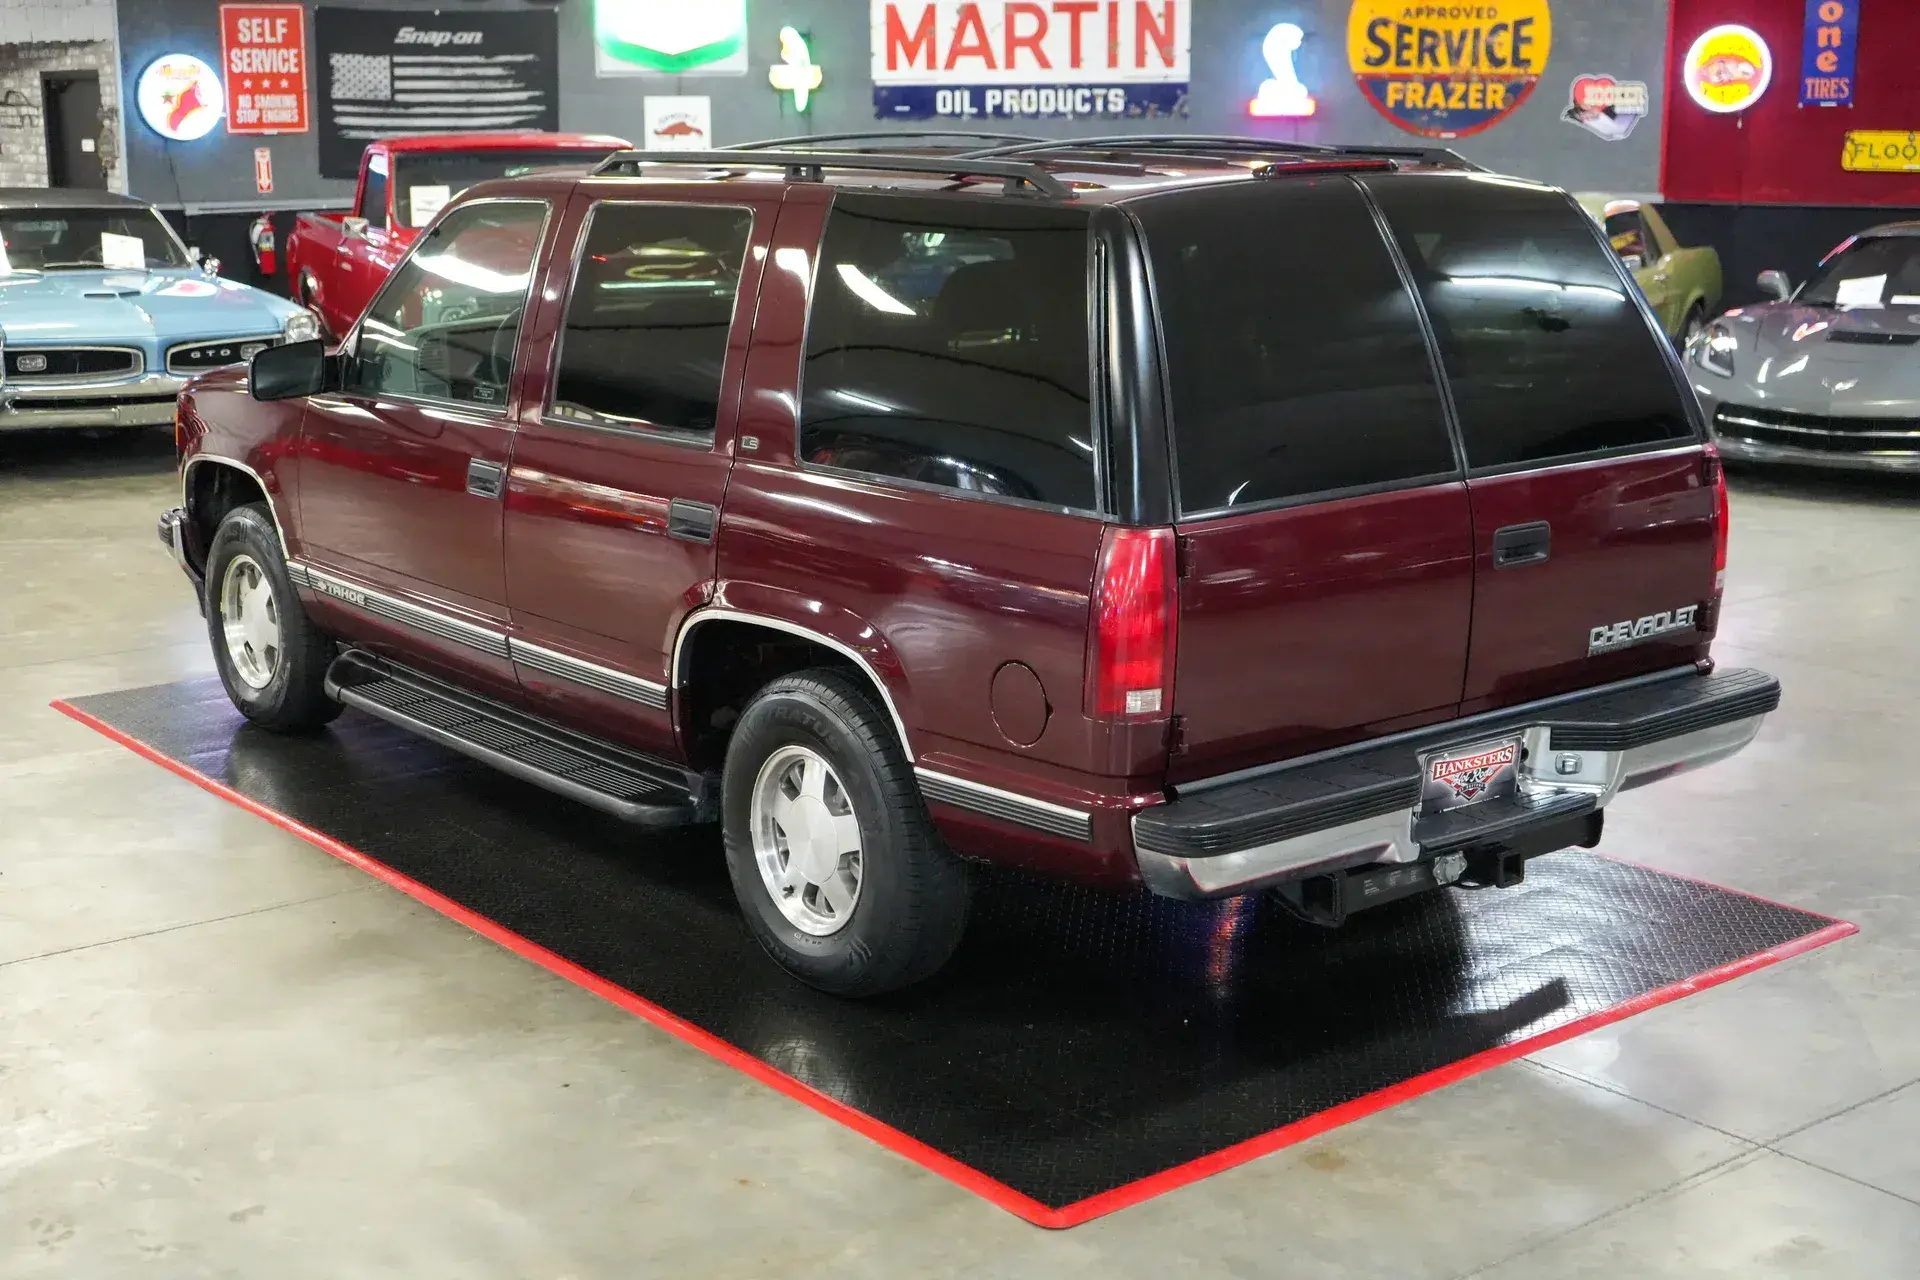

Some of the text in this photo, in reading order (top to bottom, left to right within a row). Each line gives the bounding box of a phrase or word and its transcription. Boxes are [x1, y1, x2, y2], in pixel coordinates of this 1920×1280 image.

[1403, 6, 1498, 19] APPROVED
[237, 17, 288, 43] SELF
[885, 0, 1176, 70] MARTIN
[1364, 17, 1535, 68] SERVICE
[230, 47, 300, 73] SERVICE
[935, 87, 1125, 114] OIL PRODUCTS
[1386, 81, 1506, 110] FRAZER
[1805, 76, 1850, 99] TIRES
[236, 109, 260, 124] STOP
[190, 348, 232, 359] GTO
[326, 581, 366, 606] TAHOE
[1588, 604, 1699, 648] CHEVROLET
[1434, 746, 1514, 778] HANKSTERS
